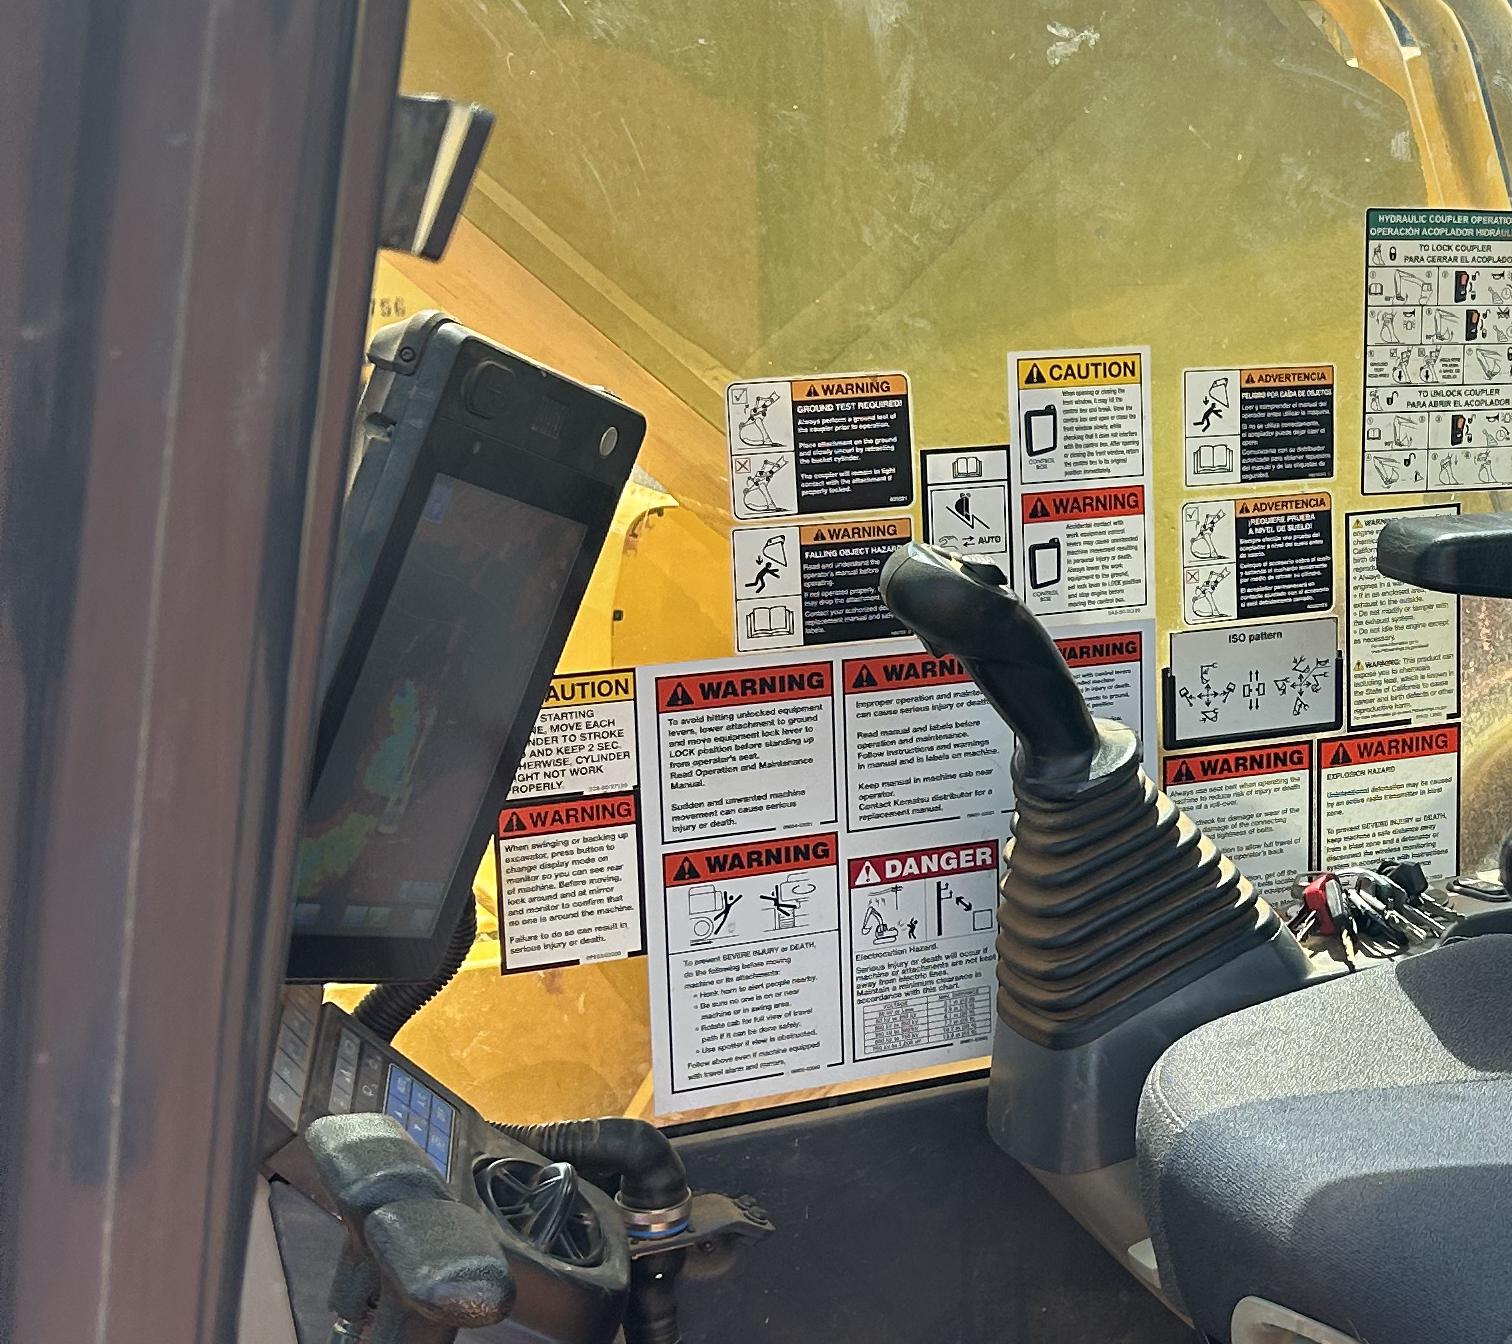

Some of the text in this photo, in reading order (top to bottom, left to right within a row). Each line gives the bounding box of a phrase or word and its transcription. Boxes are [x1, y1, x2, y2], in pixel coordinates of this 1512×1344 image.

[1379, 215, 1427, 224] HYDRAULIC
[1429, 215, 1469, 224] COUPLER
[1422, 228, 1474, 236] ACOPLADOR
[1049, 361, 1136, 381] CAUTION
[1258, 372, 1327, 383] ADVERTENCIA
[821, 381, 890, 396] WARNING
[1418, 388, 1500, 398] TO UNLOCK COUPLER
[797, 404, 834, 413] GROUND
[836, 403, 856, 411] TEST
[1428, 400, 1451, 408] ABRIR
[1464, 399, 1510, 407] ACOPLADOR
[1053, 492, 1139, 516] WARNING
[1252, 498, 1326, 512] ADVERTENCIA
[828, 525, 897, 540] WARNING
[978, 535, 1001, 545] AUTO
[805, 549, 837, 559] FALLING
[839, 547, 869, 557] OBJECT
[1228, 630, 1282, 643] ISO pattern
[883, 659, 964, 681] WARNI
[545, 678, 629, 702] AUTION
[699, 672, 824, 701] WARNING
[540, 709, 594, 723] STARTING
[668, 703, 823, 726] To avoid hitting unlocked equipment
[550, 722, 582, 734] MOVE
[586, 719, 615, 730] EACH
[669, 714, 818, 737] levers, lower attachment to ground
[528, 729, 624, 746] NDER TO STROKE
[1357, 733, 1448, 759] WARNING
[529, 741, 621, 758] AND KEEP 2 SEC.
[520, 751, 630, 770] HERWISE, CYLINDER
[1200, 750, 1304, 776] WARNING
[517, 765, 603, 782] GHT NOT WORK
[1327, 766, 1395, 780] EXPLOSION HAZARD
[512, 781, 564, 794] ROPERLY.
[530, 801, 632, 828] WARNING
[505, 843, 528, 853] When
[531, 839, 569, 850] swinging
[583, 833, 615, 843] backing
[618, 832, 628, 840] up
[551, 849, 574, 859] press
[576, 845, 604, 855] button
[706, 842, 829, 874] WARNING
[506, 855, 608, 875] change display mode on
[885, 847, 992, 879] DANGER
[507, 864, 623, 884] monitor so you can see rear
[507, 887, 515, 896] of
[518, 883, 555, 895] machine.
[559, 879, 586, 889] Before
[508, 885, 614, 906] look around and at mirror
[509, 895, 623, 917] and monitor to confirm that
[509, 904, 634, 927] no one is around the machine.
[510, 933, 538, 944] Failure
[541, 931, 549, 939] to
[552, 930, 562, 938] do
[565, 929, 574, 937] so
[577, 927, 592, 935] can
[595, 922, 617, 932] result
[511, 944, 541, 954] serious
[544, 940, 566, 950] injury
[580, 936, 606, 945] death.
